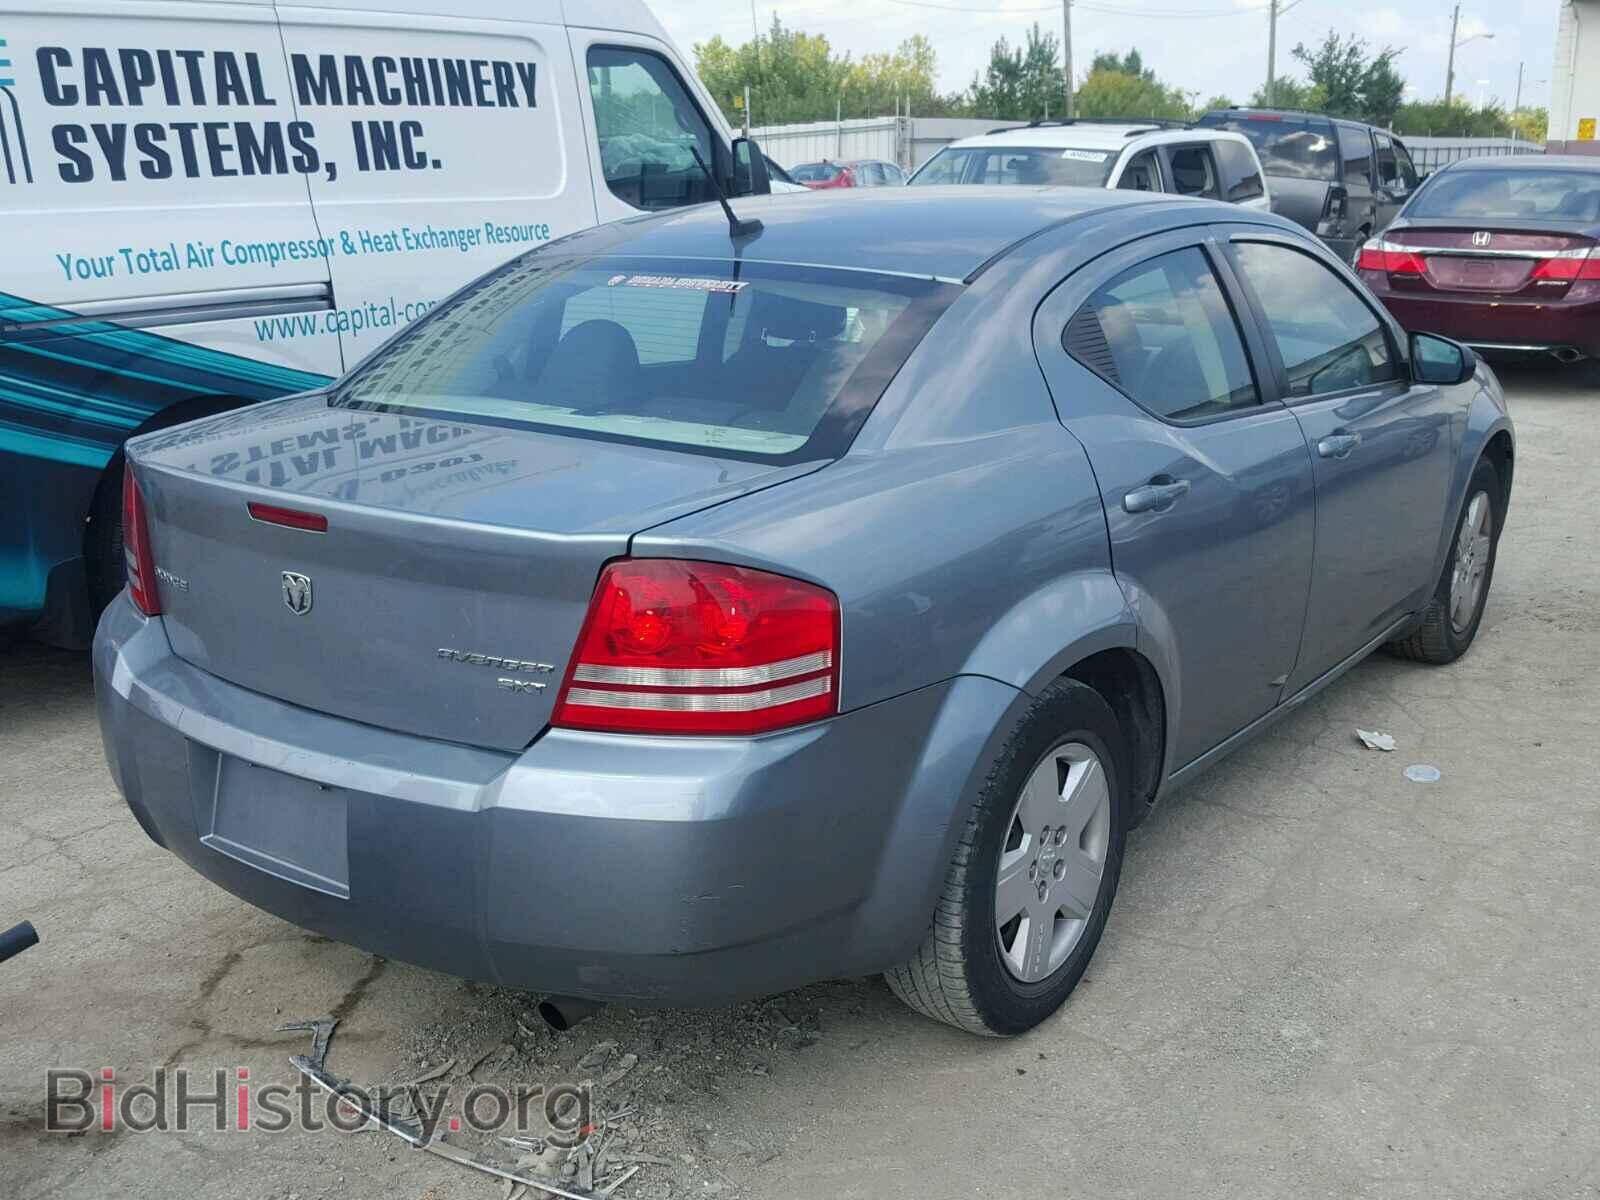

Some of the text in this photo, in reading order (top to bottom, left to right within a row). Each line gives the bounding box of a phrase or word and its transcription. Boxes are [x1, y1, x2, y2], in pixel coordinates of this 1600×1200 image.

[36, 46, 537, 108] CAPITAL MACHINERY
[52, 120, 442, 183] SYSTEMS, INC.
[56, 222, 550, 281] Your Total Air Compressor & Heat Exchanger Resource
